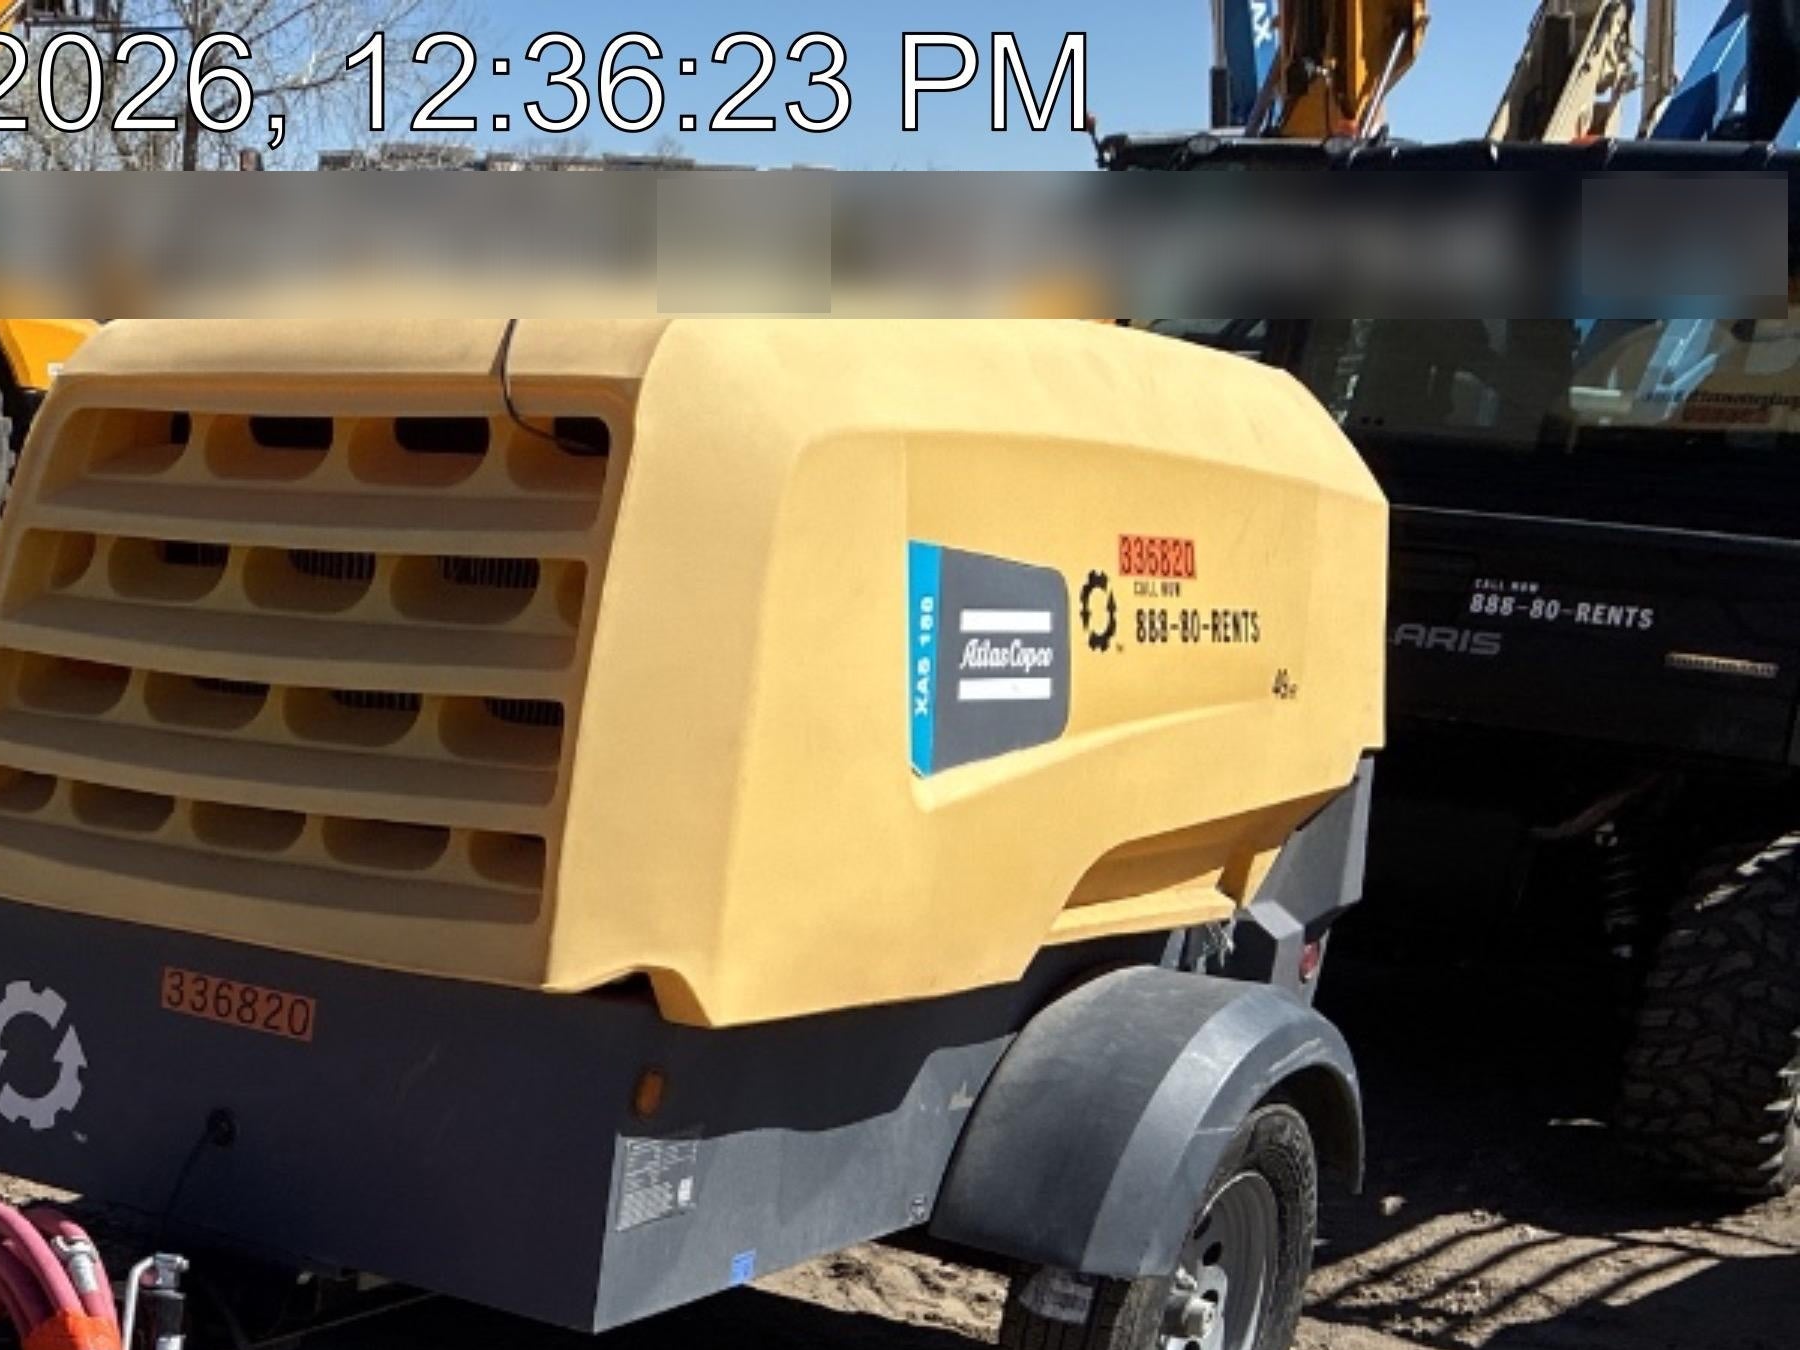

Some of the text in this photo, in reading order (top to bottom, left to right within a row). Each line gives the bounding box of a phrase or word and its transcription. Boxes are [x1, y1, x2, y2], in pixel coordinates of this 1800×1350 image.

[1134, 608, 1261, 644] 888-80-RENTS
[1468, 593, 1655, 630] 888-80-RENTS
[166, 970, 311, 1037] 336820
